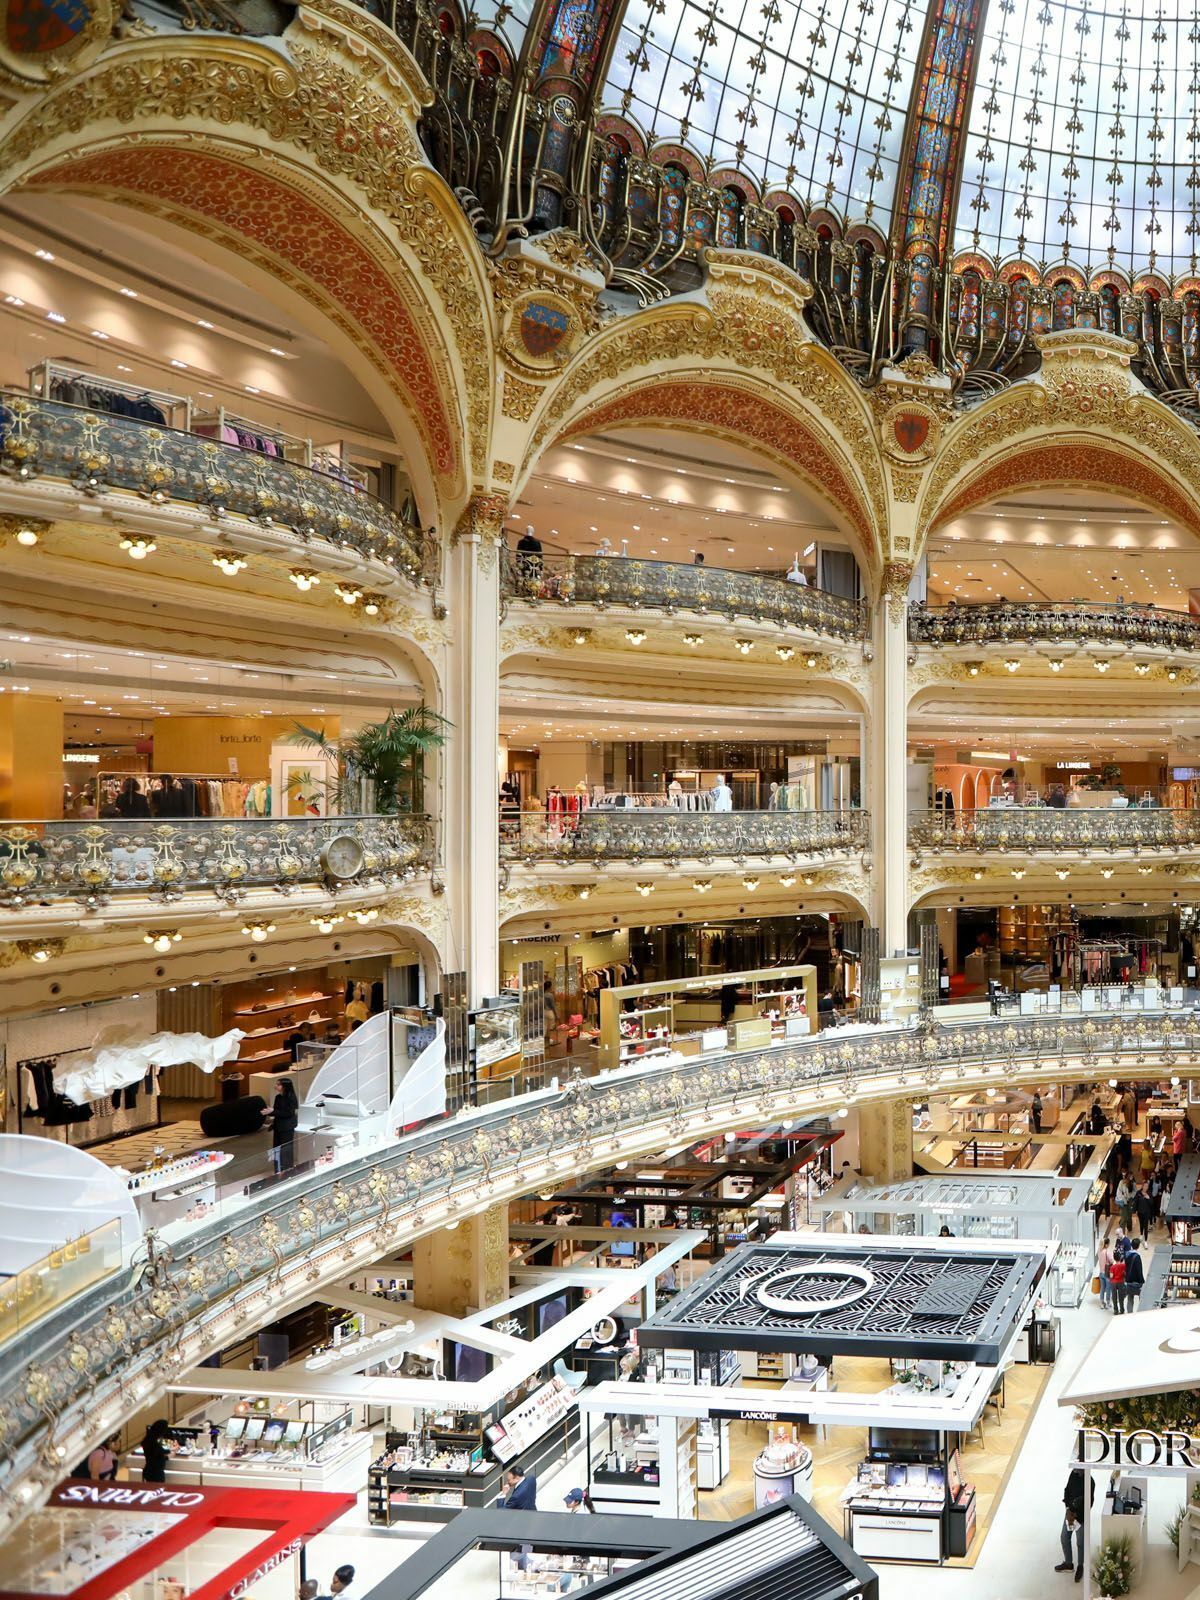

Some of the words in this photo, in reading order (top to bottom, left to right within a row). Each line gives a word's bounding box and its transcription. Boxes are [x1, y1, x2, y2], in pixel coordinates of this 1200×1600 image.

[740, 1410, 778, 1421] LANCÔME
[1074, 1428, 1197, 1468] DIOR
[60, 1485, 205, 1506] CLARINS
[228, 1537, 303, 1600] CLARINS
